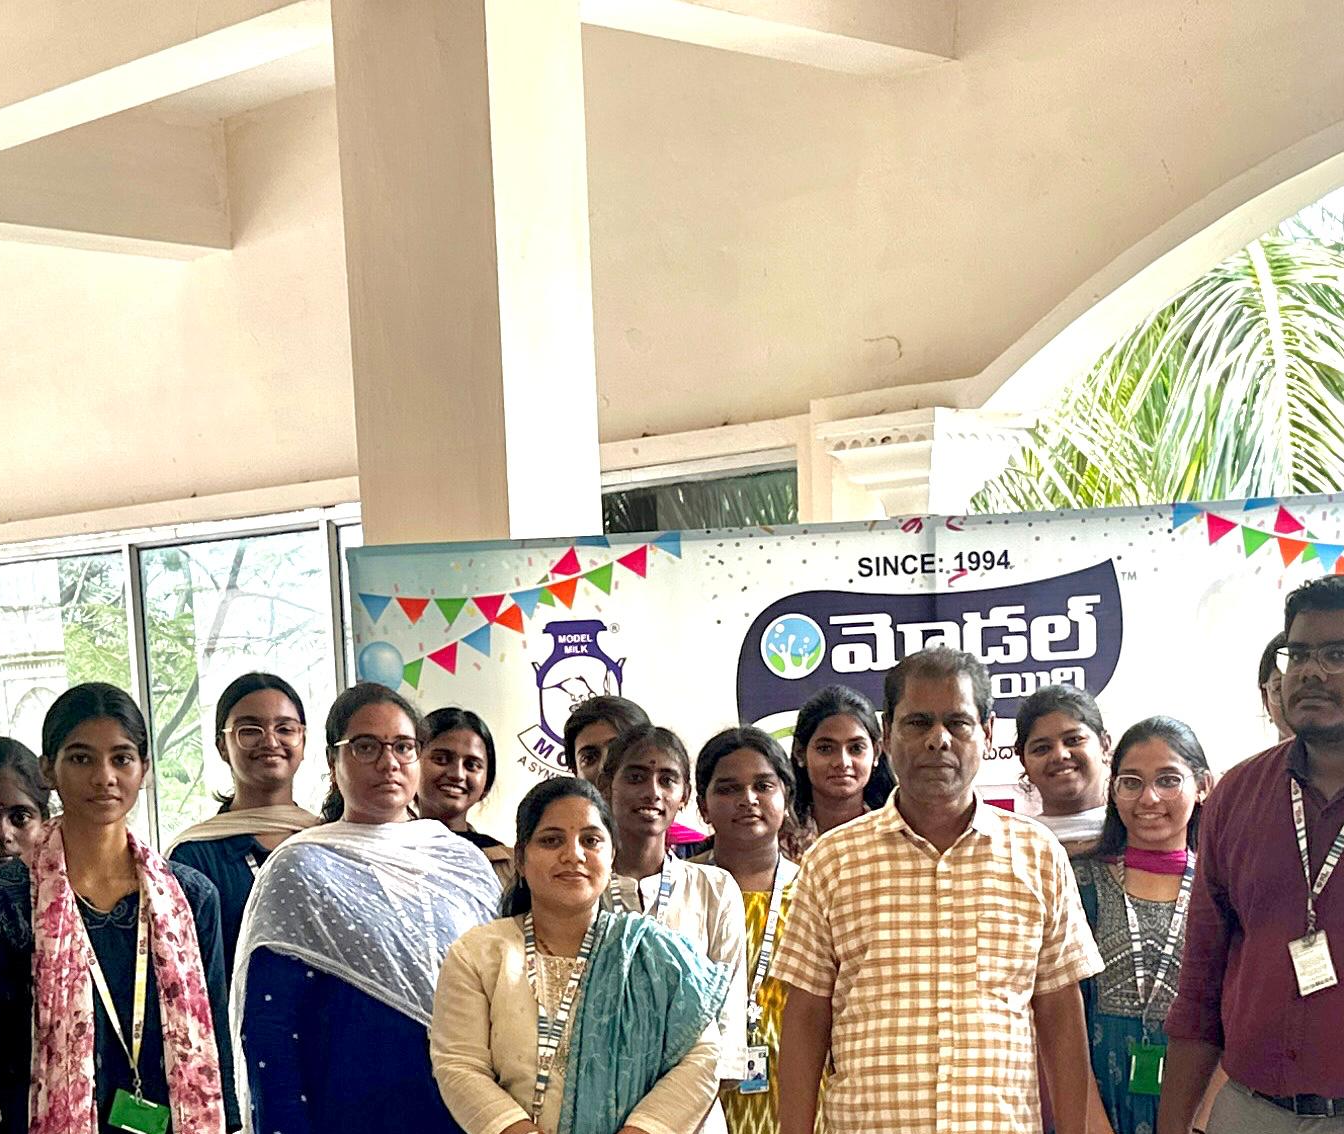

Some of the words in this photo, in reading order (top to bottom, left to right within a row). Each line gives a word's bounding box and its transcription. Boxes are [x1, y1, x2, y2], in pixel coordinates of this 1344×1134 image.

[857, 554, 944, 577] SINCE:
[954, 549, 1010, 572] 1994
[558, 634, 593, 644] MODEL
[564, 645, 588, 654] MILK
